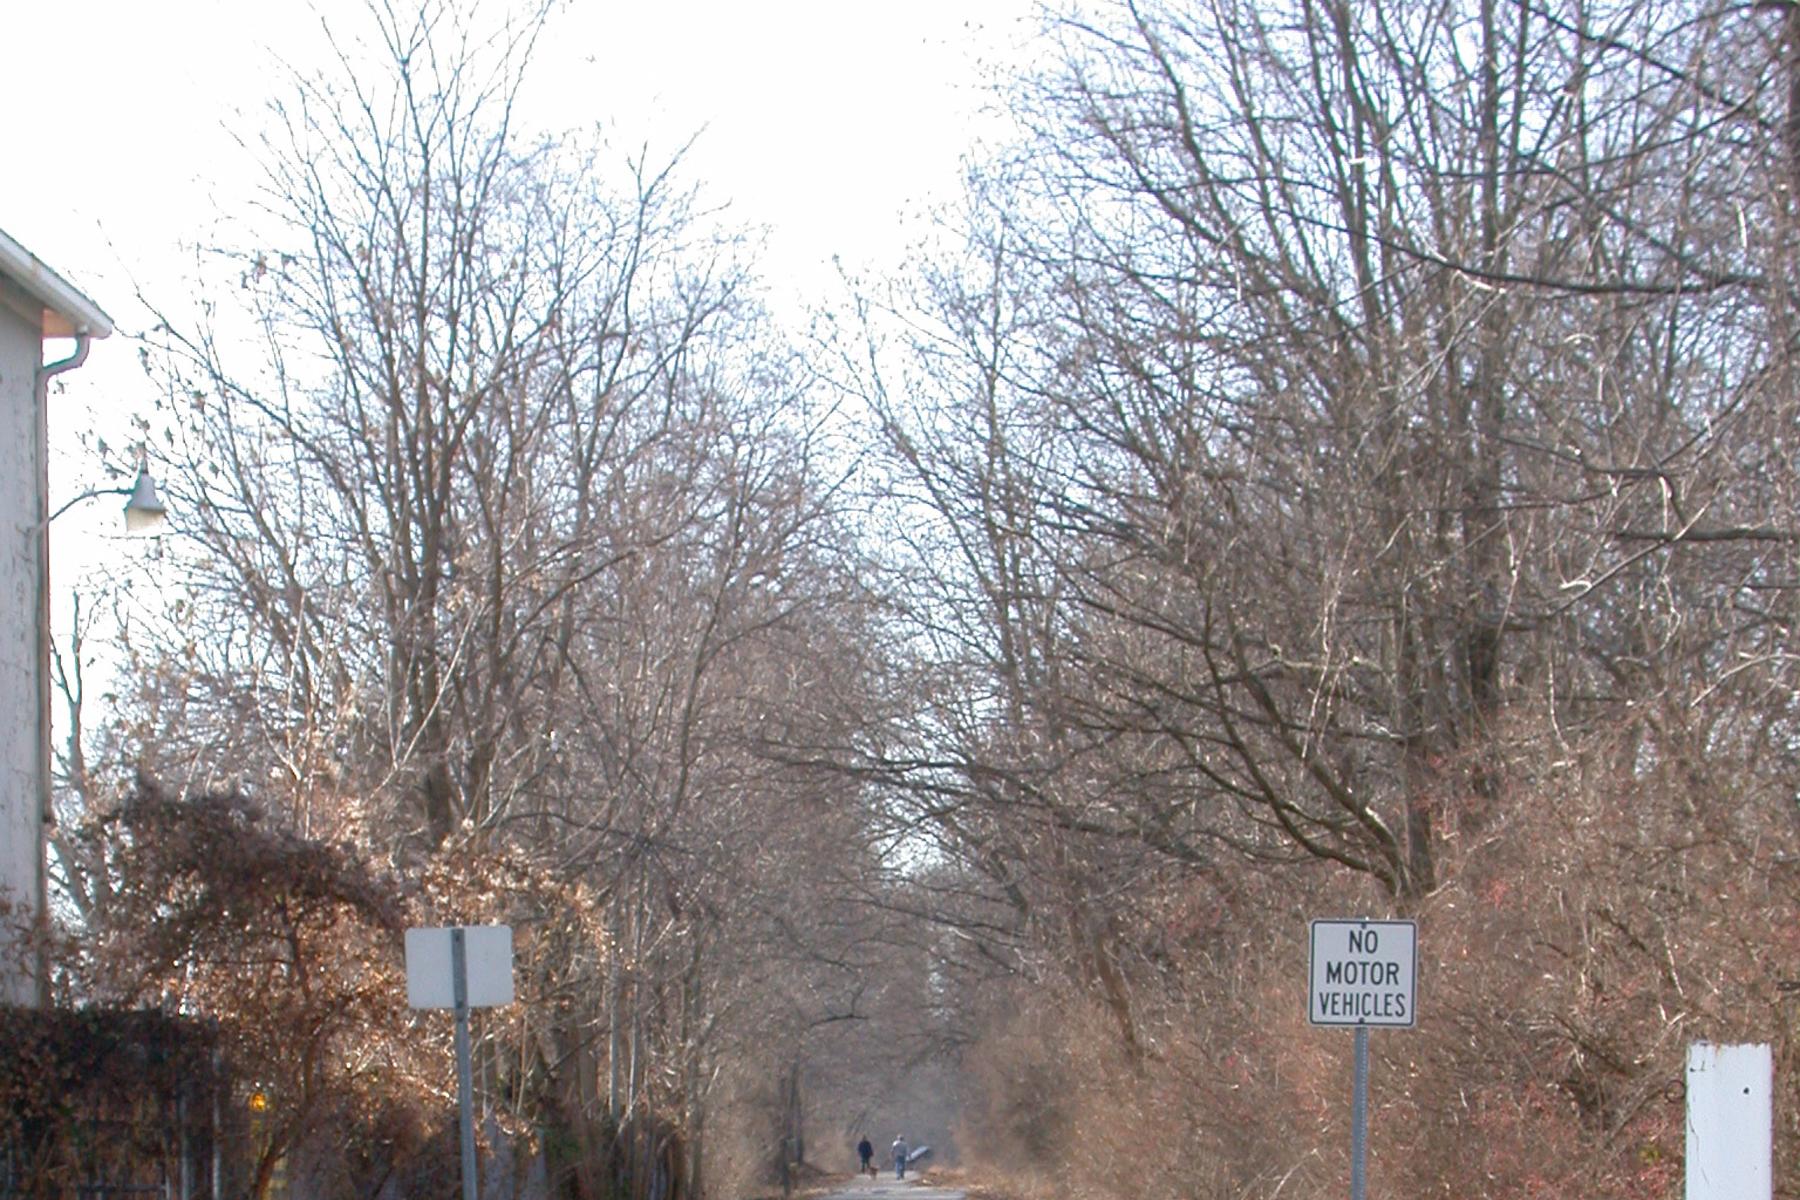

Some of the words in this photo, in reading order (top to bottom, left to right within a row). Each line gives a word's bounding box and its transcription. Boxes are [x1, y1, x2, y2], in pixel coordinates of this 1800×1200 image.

[1349, 930, 1378, 953] NO
[1326, 961, 1400, 985] MOTOR
[1319, 992, 1406, 1017] VEHICLES
